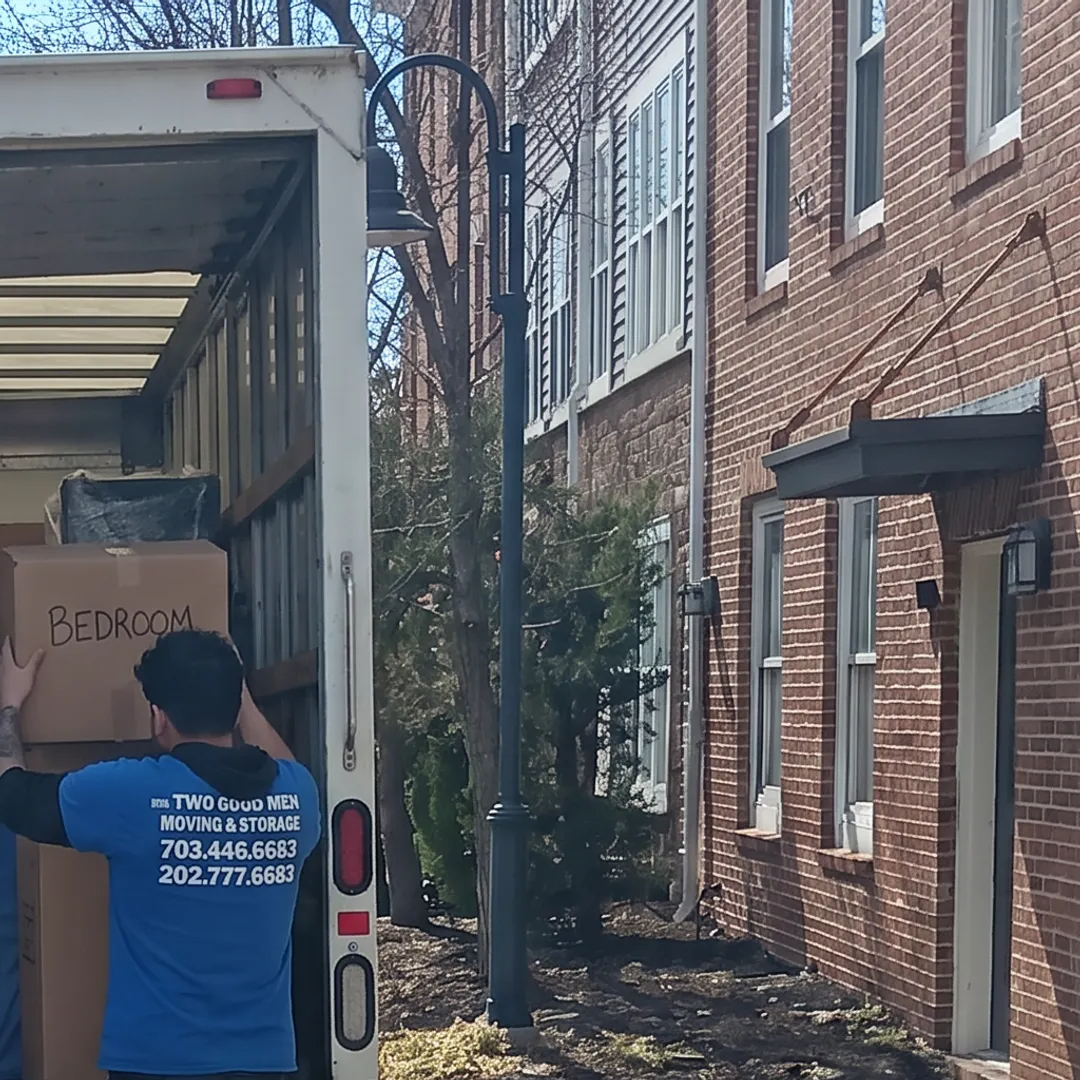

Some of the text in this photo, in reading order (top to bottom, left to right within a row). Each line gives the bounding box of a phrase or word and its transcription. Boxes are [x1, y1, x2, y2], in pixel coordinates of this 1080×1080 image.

[48, 604, 193, 647] BEDROOM
[172, 793, 215, 811] TWO
[217, 797, 264, 812] GOOD
[266, 794, 300, 811] MEN
[160, 815, 301, 833] MOVING & STORAGE
[160, 838, 298, 860] 703.446.6683
[158, 863, 296, 887] 202.777.6683
